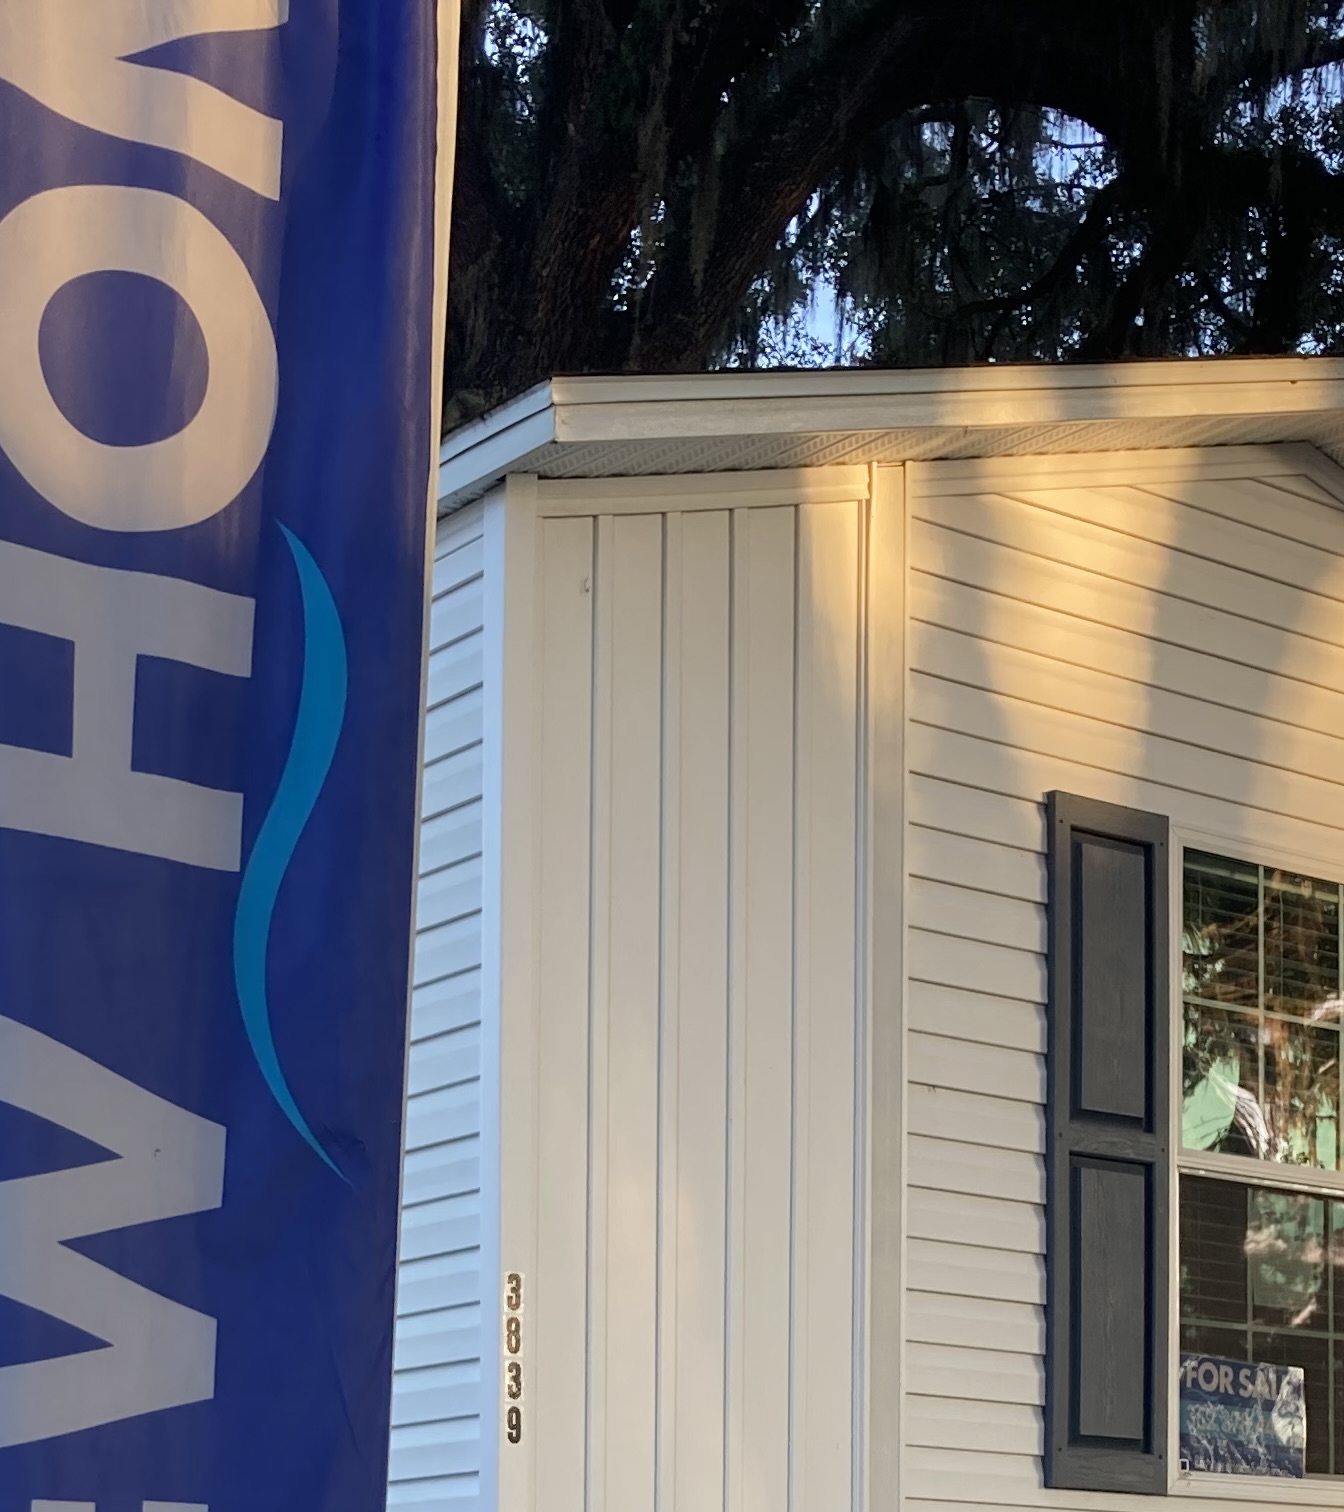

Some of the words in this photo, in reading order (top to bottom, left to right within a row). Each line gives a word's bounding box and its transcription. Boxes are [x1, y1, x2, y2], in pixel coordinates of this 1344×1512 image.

[506, 1272, 523, 1445] 3839
[1186, 1361, 1235, 1396] FOR
[1238, 1367, 1288, 1402] SAL
